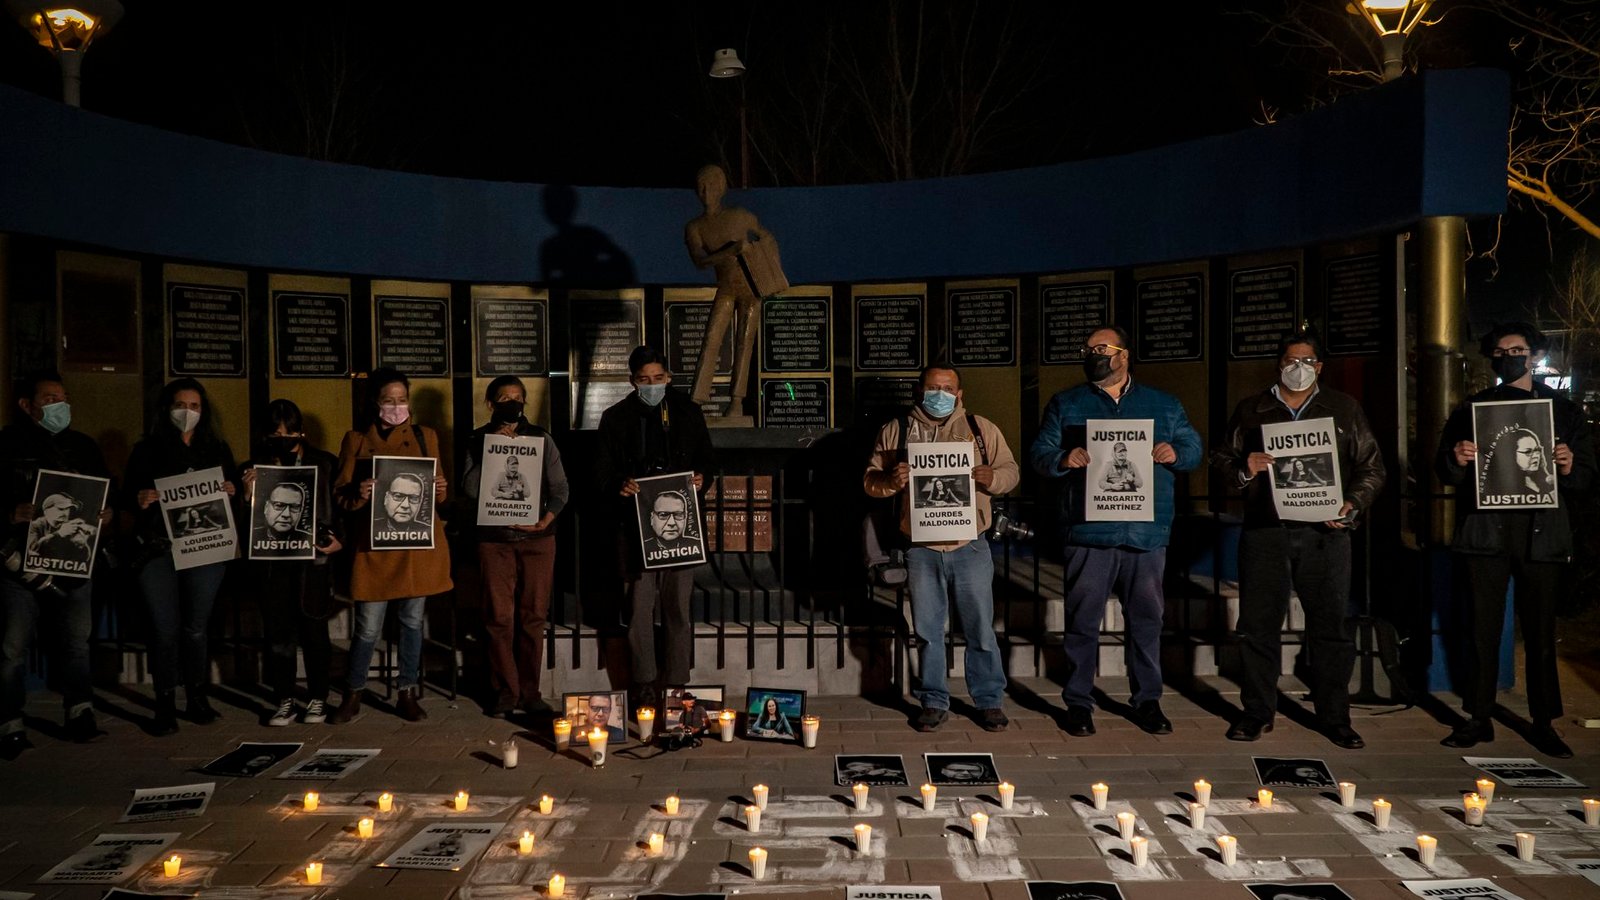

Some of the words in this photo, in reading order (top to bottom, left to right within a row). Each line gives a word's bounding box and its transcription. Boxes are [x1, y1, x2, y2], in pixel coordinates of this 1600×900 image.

[1092, 431, 1147, 442] JUSTICIA
[1268, 431, 1332, 451] JUSTICIA
[488, 444, 537, 456] JUSTICIA
[911, 453, 970, 469] JUSTICIA
[162, 480, 222, 503] JUSTICIA
[1283, 499, 1337, 507] MALDONADO
[1482, 494, 1553, 505] JUSTICIA
[488, 510, 529, 518] MARTÍNEZ
[919, 519, 971, 527] MALDONADO
[184, 534, 224, 546] LOURDES
[374, 531, 429, 540] JUSTICIA
[180, 540, 233, 554] MALDONADO
[254, 540, 310, 550] JUSTICIA
[647, 546, 700, 561] JUSTICIA
[27, 556, 87, 572] JUSTICIA
[134, 792, 206, 802] JUSTICIA
[1422, 886, 1498, 896] JUSTICIA
